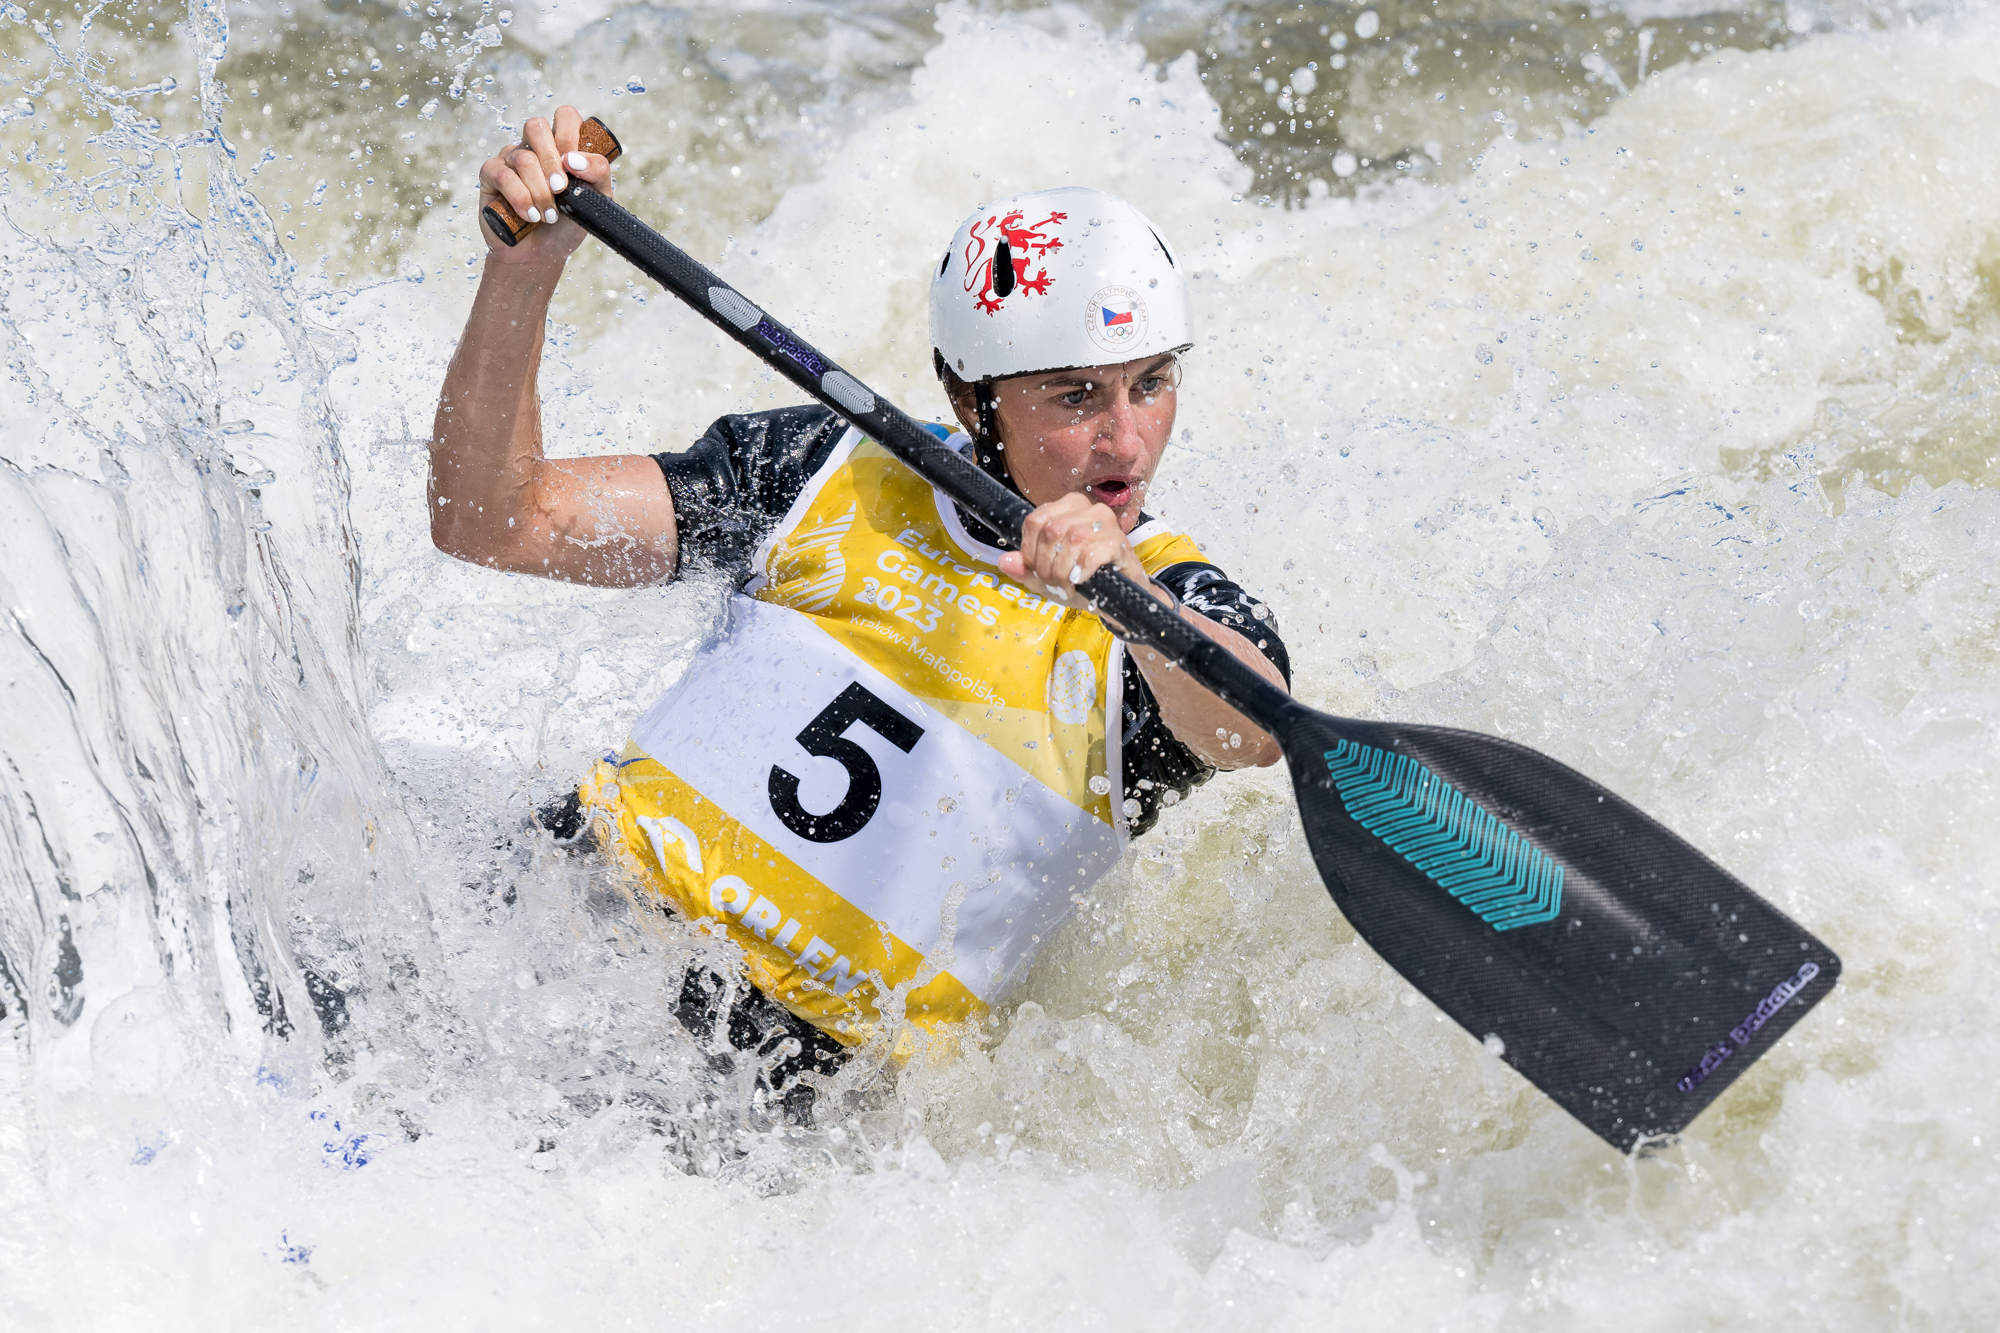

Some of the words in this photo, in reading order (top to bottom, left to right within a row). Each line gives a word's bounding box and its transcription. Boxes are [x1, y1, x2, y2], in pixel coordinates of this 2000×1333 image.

[1087, 301, 1098, 331] CZECH
[1097, 287, 1134, 300] OLYMPIC
[1135, 297, 1147, 322] TEAM
[854, 577, 944, 633] 2023
[876, 549, 1001, 626] Games
[894, 528, 1066, 622] European
[850, 612, 1006, 710] Kraków-Małopolska
[768, 681, 925, 843] 5
[709, 875, 869, 996] ORLEN
